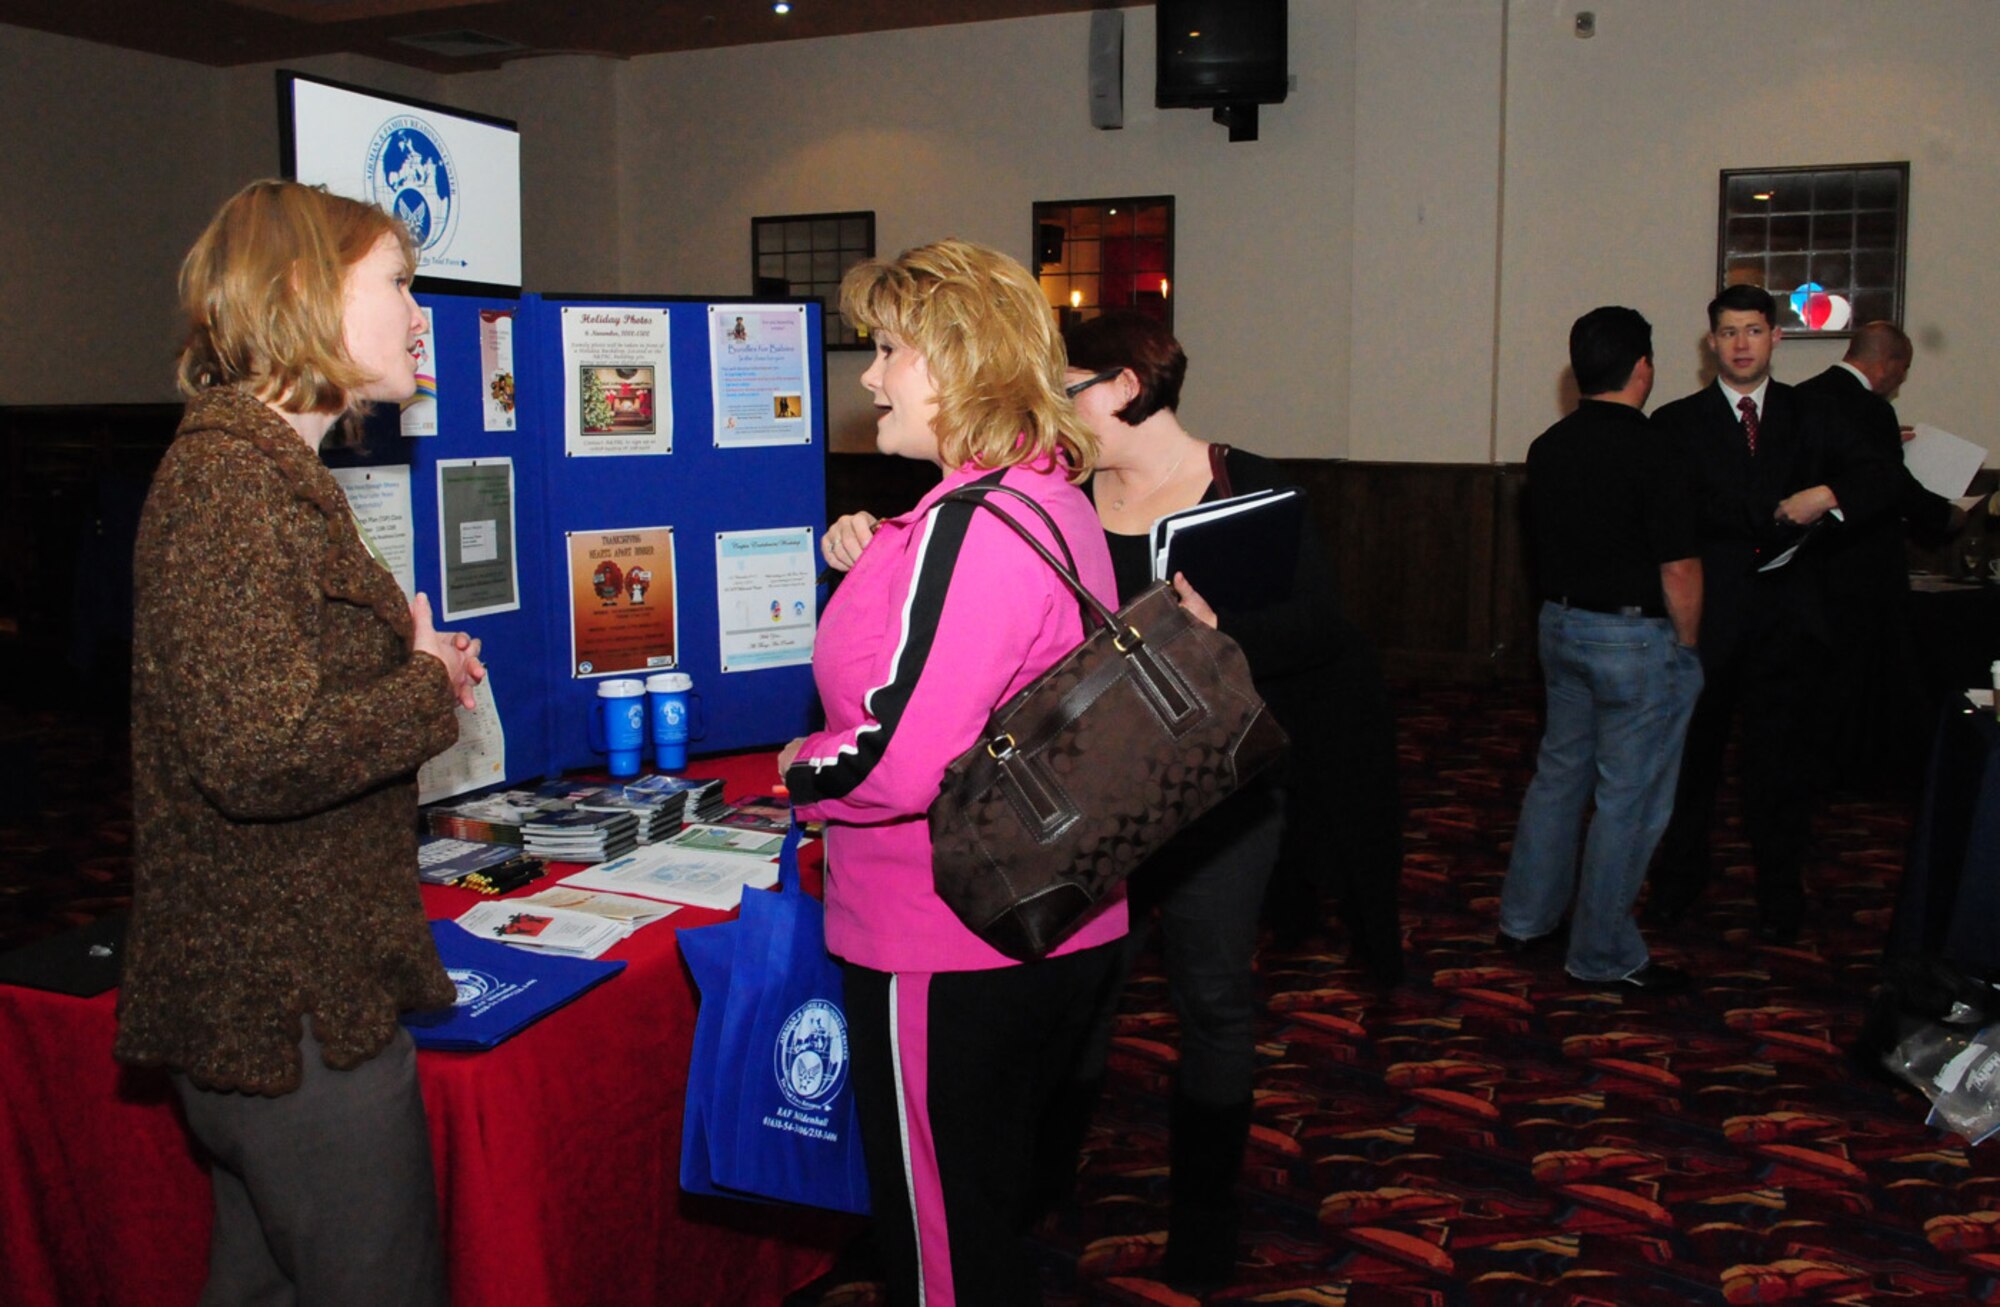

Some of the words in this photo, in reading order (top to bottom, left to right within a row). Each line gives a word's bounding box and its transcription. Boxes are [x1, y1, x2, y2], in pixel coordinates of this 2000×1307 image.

[367, 141, 380, 180] AIRMAN
[383, 119, 409, 135] FAMILY
[410, 119, 444, 152] READINESS
[443, 153, 456, 195] CENTER
[580, 313, 620, 327] Holiday
[623, 313, 652, 325] Photos
[728, 344, 757, 355] Bundles
[758, 344, 769, 352] for
[770, 344, 795, 353] Babies
[601, 534, 642, 546] THANKSGIVING
[588, 548, 613, 559] HEARTS
[614, 547, 633, 558] APART
[634, 545, 655, 556] DINNER
[1966, 1052, 2000, 1092] Hefty
[776, 1106, 795, 1118] RAF
[794, 1110, 830, 1127] Mildenhall
